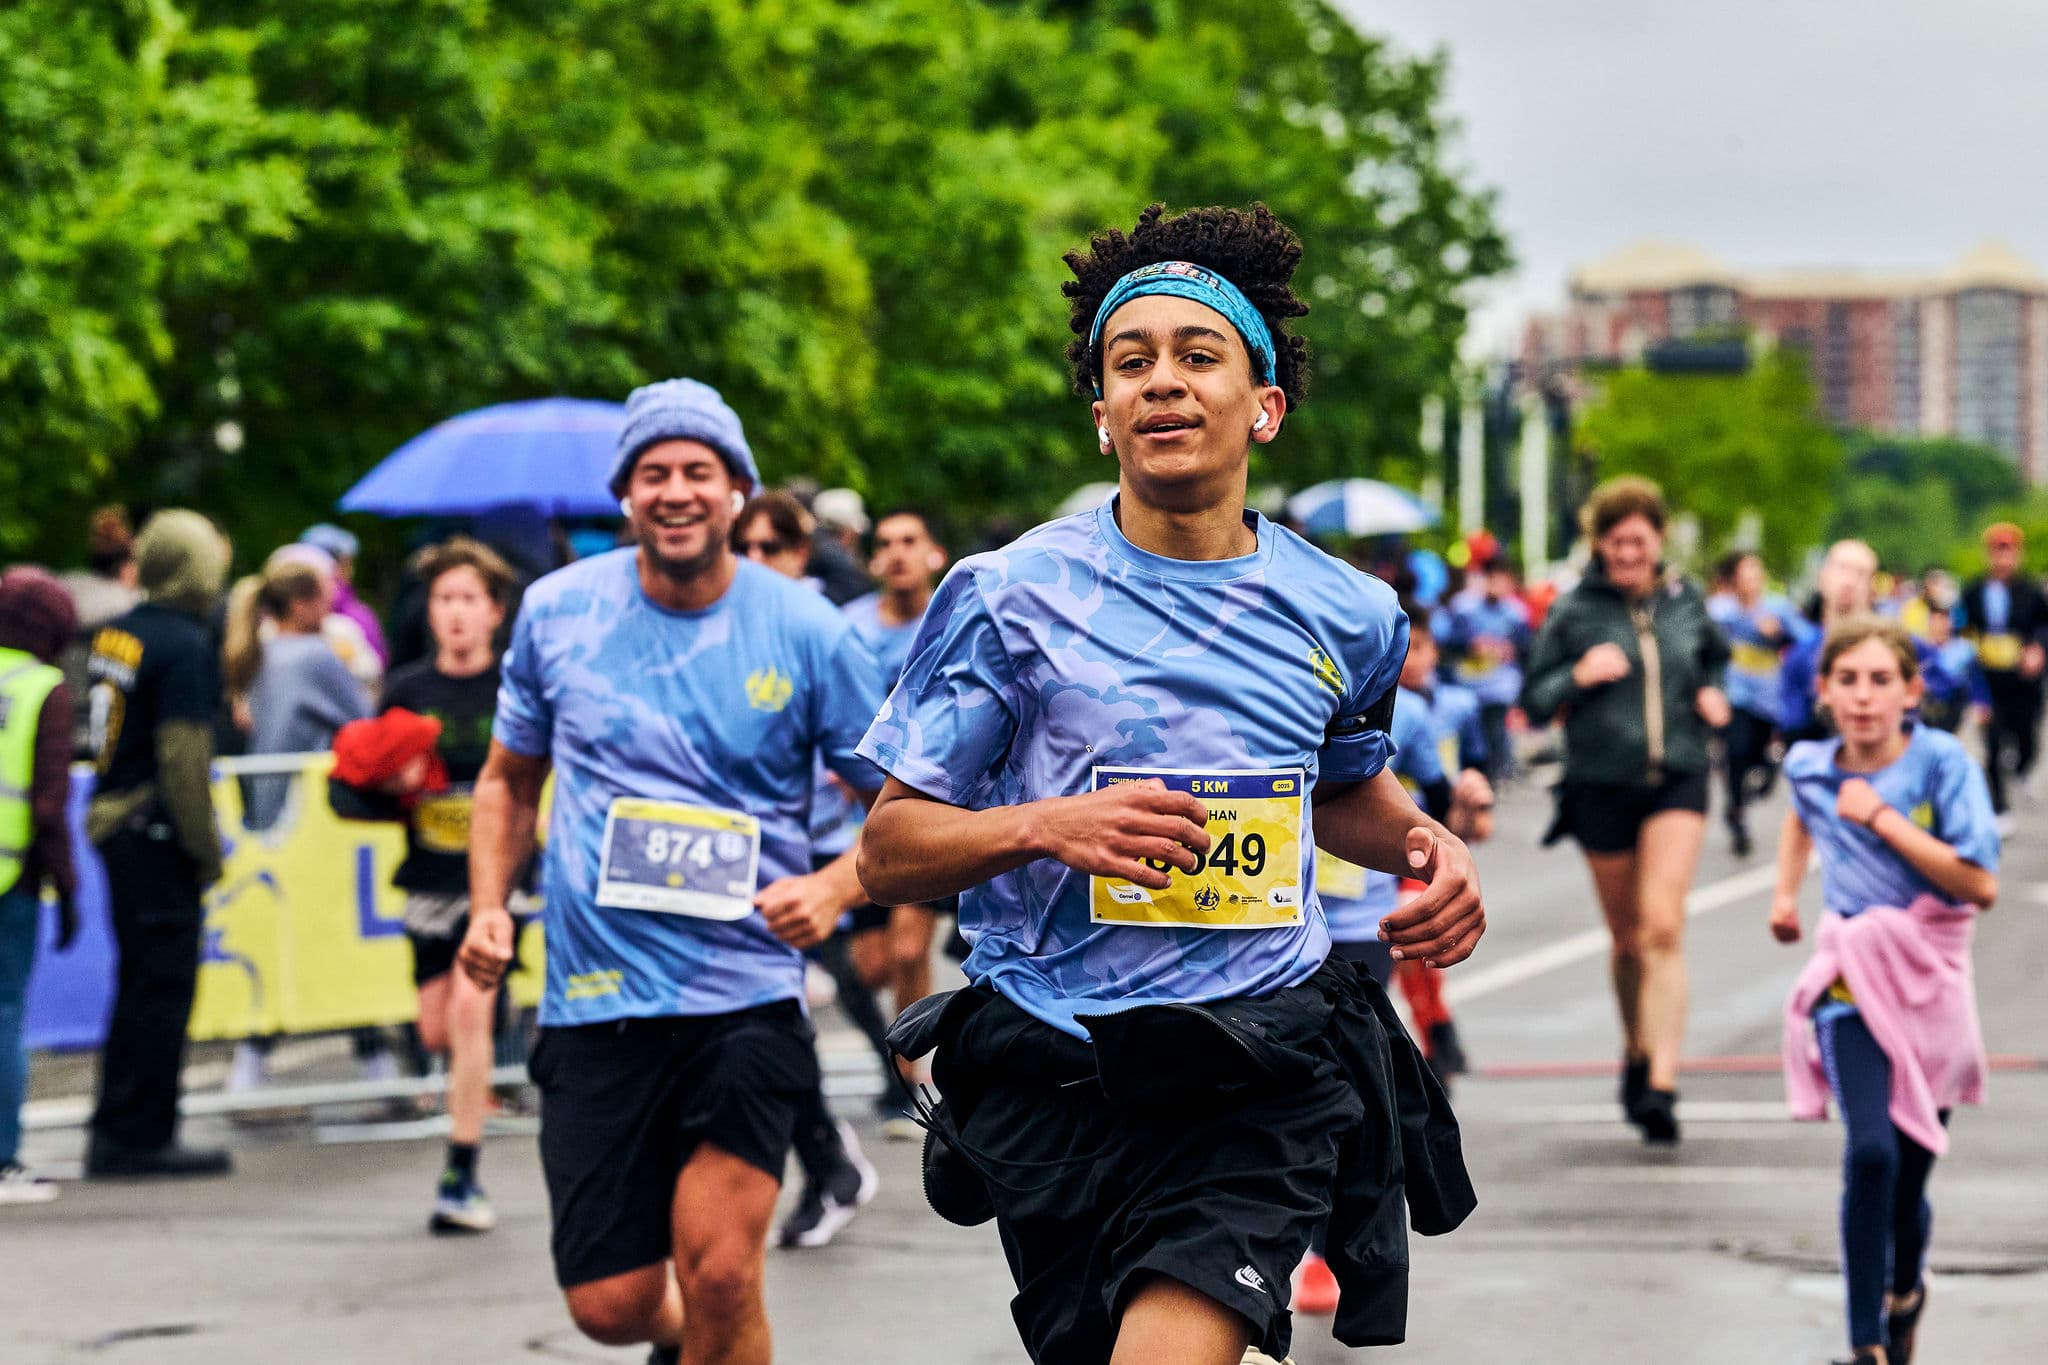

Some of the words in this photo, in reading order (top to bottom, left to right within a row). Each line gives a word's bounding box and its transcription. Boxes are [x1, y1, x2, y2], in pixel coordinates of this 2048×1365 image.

[1191, 780, 1201, 793] 5
[1203, 780, 1229, 793] KM
[645, 828, 713, 869] 874
[1241, 1264, 1265, 1286] NIKE
